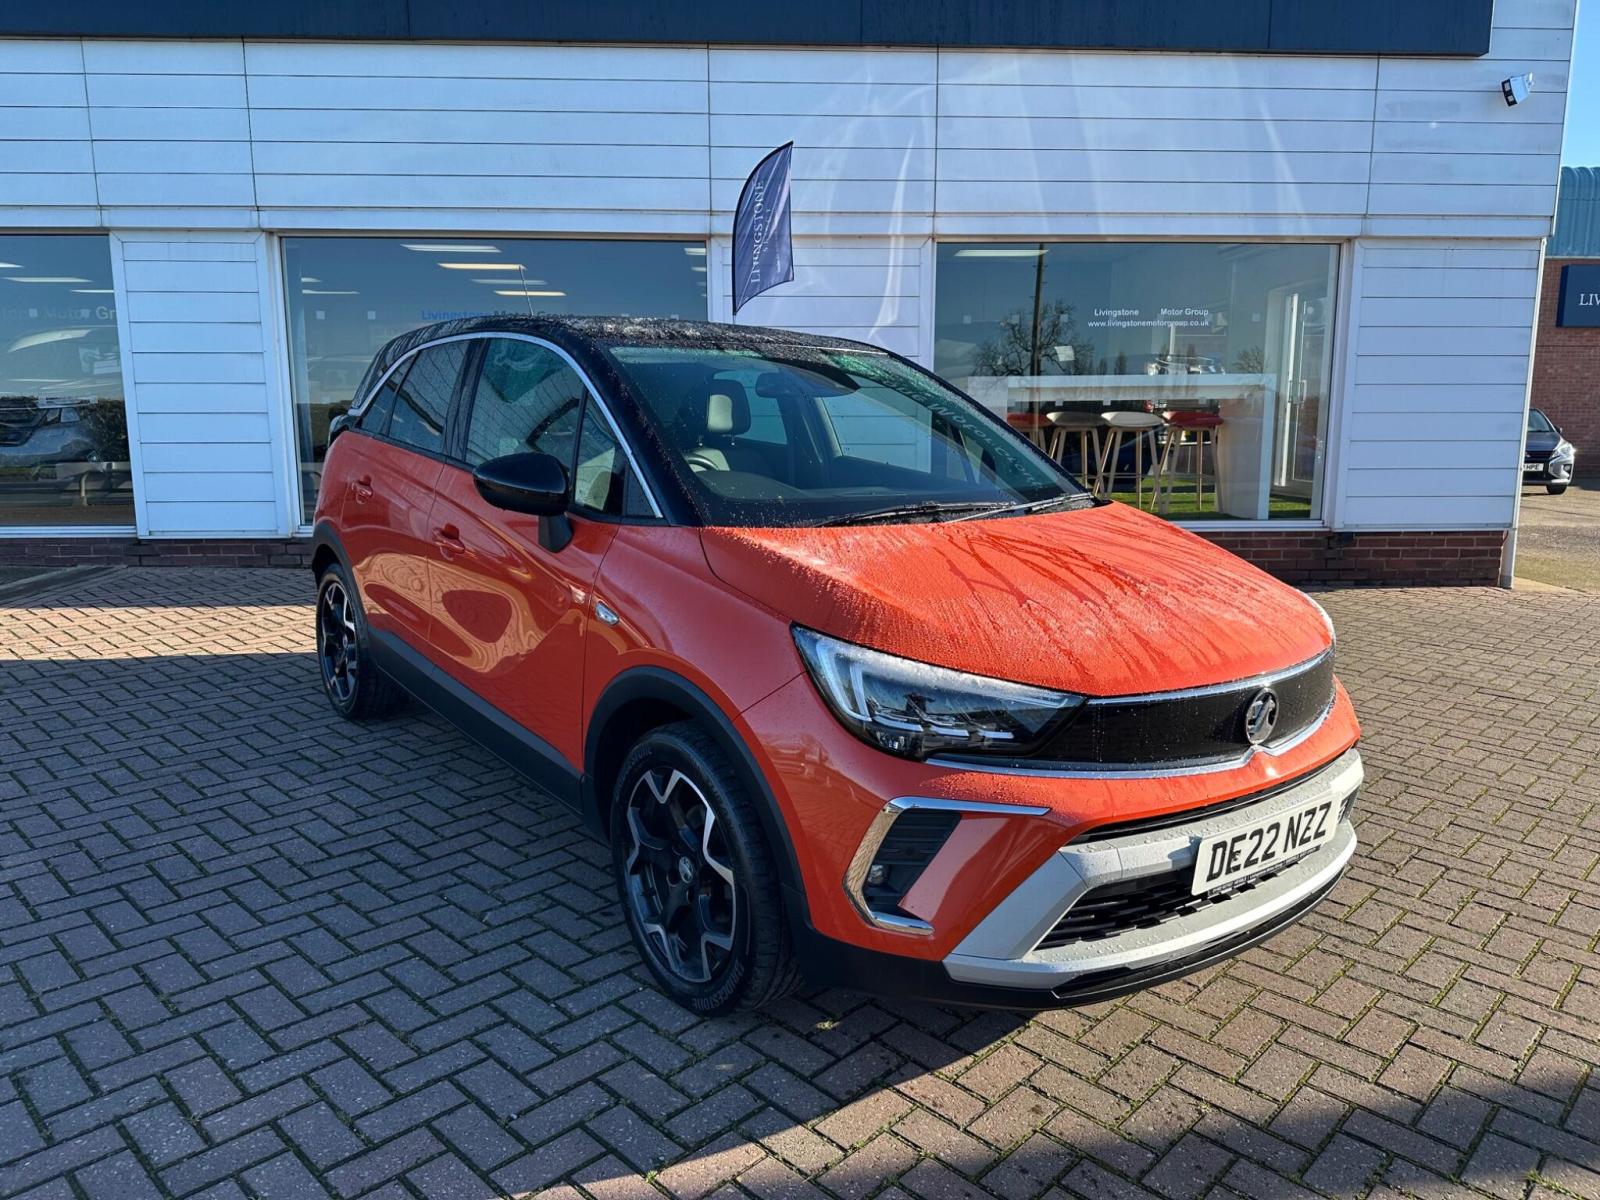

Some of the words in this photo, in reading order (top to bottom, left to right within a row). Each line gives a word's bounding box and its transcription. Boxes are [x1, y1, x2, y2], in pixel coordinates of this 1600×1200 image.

[751, 181, 764, 283] LIVINGSTONE
[1087, 319, 1209, 328] www.livingstonemotorgroup.co.uk
[1094, 308, 1140, 318] Livingstone
[1160, 308, 1183, 316] Motor
[1184, 307, 1209, 317] Group
[1206, 821, 1281, 882] DE22
[1283, 800, 1332, 853] NZZ
